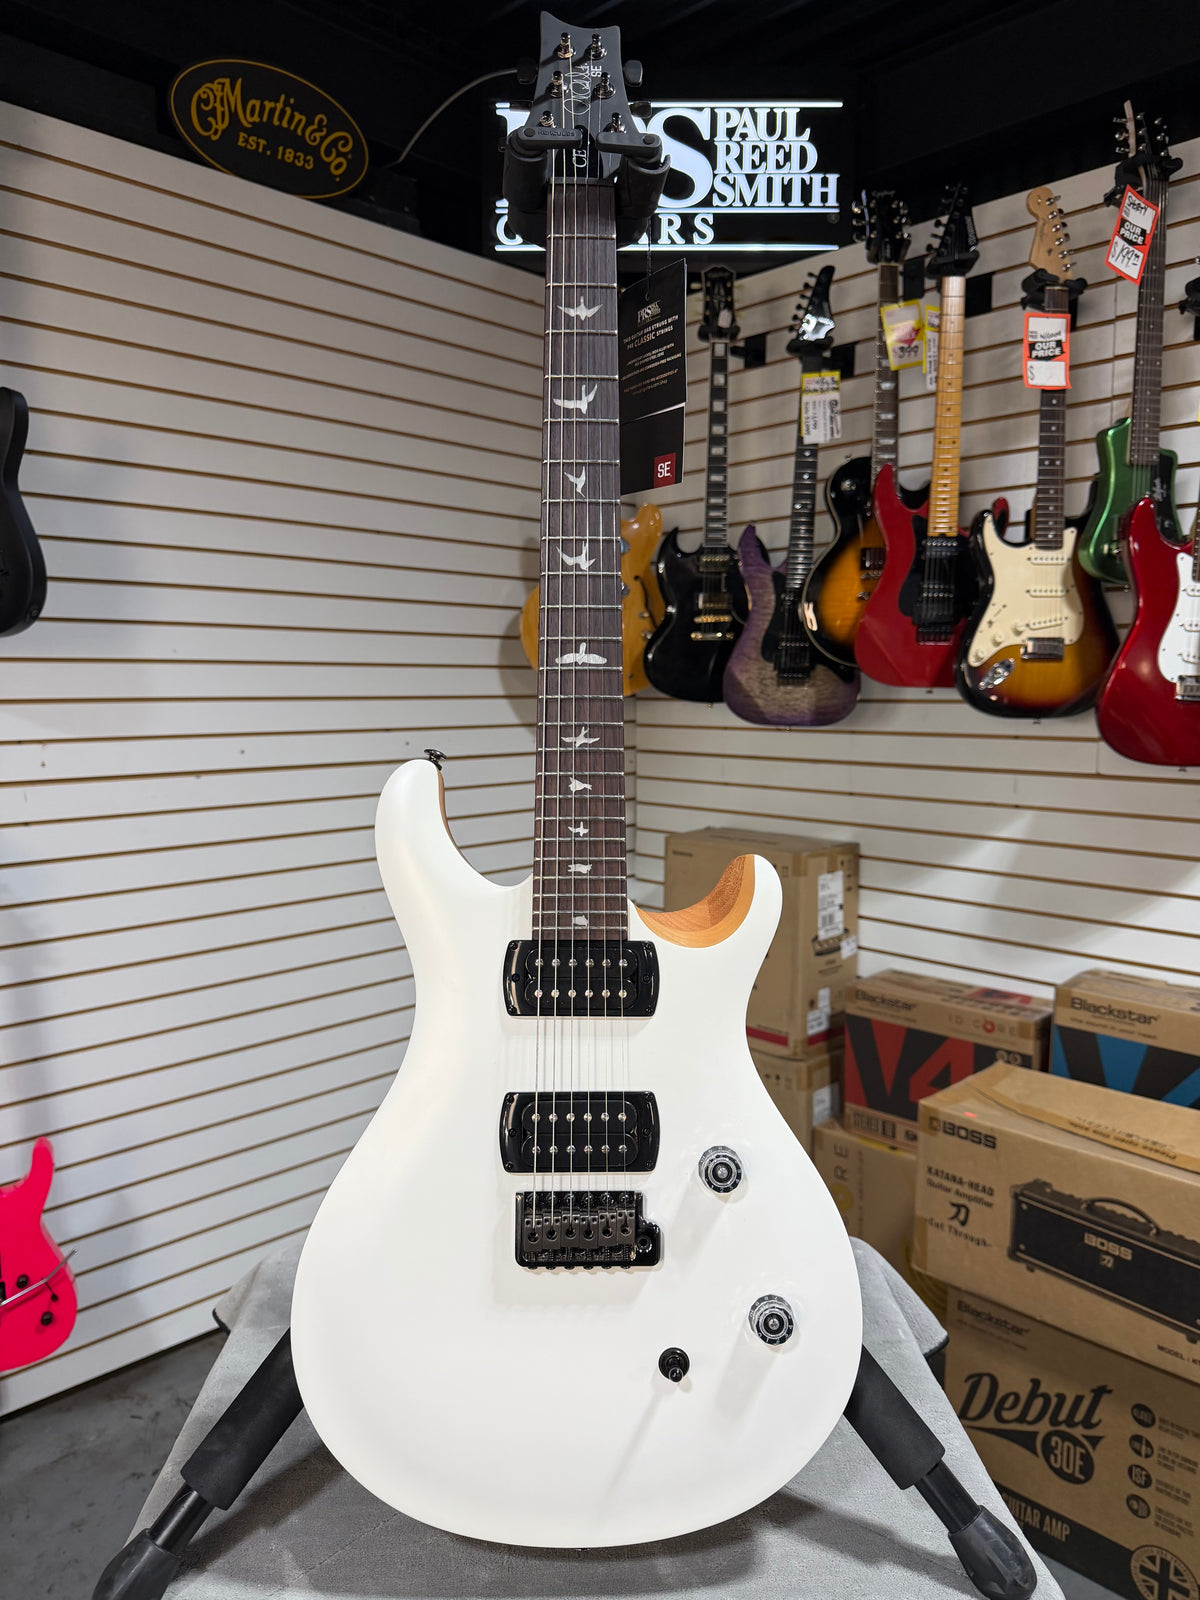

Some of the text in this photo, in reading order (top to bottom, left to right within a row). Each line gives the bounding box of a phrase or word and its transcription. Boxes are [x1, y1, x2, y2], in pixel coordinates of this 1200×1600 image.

[714, 107, 811, 141] PAUL
[238, 132, 314, 170] EST. 1833
[713, 141, 818, 174] REED
[712, 173, 840, 207] SMITH
[1119, 228, 1145, 245] PRICE
[1124, 221, 1142, 236] OUR
[634, 331, 656, 348] CLASSIC
[1031, 347, 1062, 359] PRICE
[1034, 341, 1057, 351] OUR
[657, 460, 671, 479] SE
[1070, 996, 1158, 1025] Blackstar
[942, 1121, 997, 1149] BOSS
[926, 1165, 995, 1197] KATANA-HEAD
[954, 1187, 994, 1209] Amplifier
[1084, 1231, 1133, 1261] BOSS
[960, 1372, 1114, 1430] Debut
[1049, 1436, 1087, 1485] 30E
[1043, 1514, 1070, 1542] AMP
